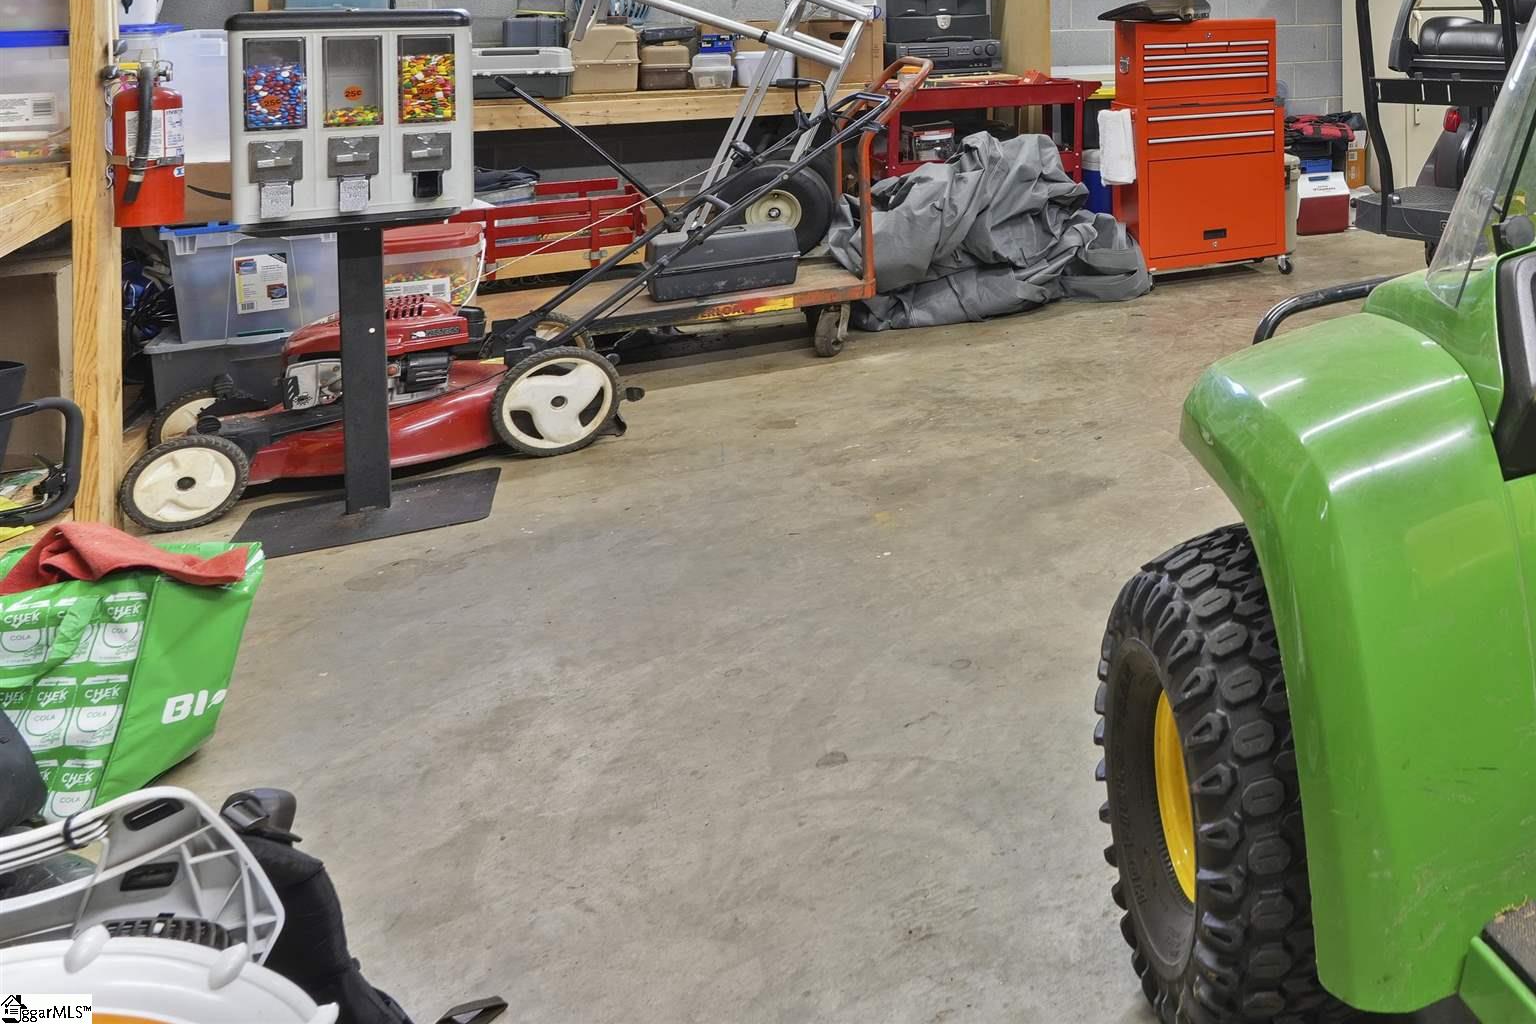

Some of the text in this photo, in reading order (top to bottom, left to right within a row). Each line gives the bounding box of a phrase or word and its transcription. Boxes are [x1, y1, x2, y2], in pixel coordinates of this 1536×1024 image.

[344, 90, 362, 98] 25¢
[264, 99, 281, 107] 25¢
[107, 601, 142, 621] CHEK
[4, 608, 41, 628] CHEK
[10, 634, 31, 642] COLA
[36, 687, 68, 707] CHEK
[84, 684, 121, 704] CHEK
[33, 713, 56, 722] COLA
[86, 711, 107, 719] COLA
[61, 770, 94, 789] CHEK
[59, 796, 82, 806] COLA
